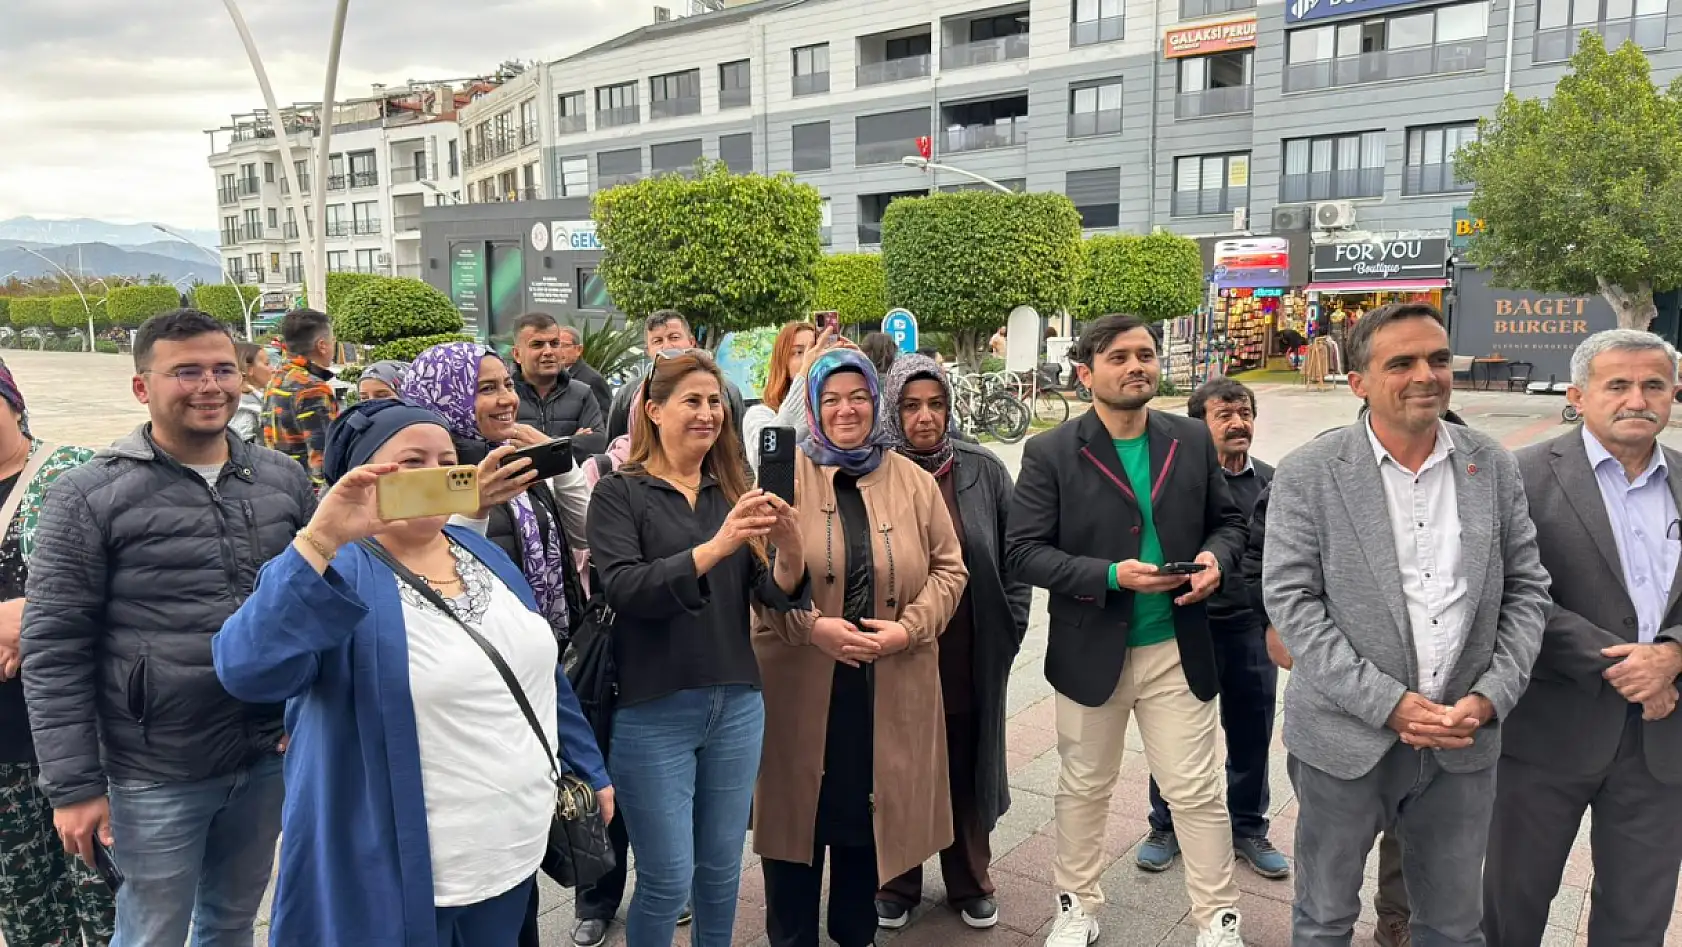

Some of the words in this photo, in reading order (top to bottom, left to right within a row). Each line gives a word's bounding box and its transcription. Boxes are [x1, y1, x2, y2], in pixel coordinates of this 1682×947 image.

[1335, 243, 1374, 261] FOR
[1380, 241, 1422, 261] YOU
[1353, 262, 1400, 278] Boutique
[1494, 298, 1590, 316] BAGET
[1493, 319, 1588, 334] BURGER
